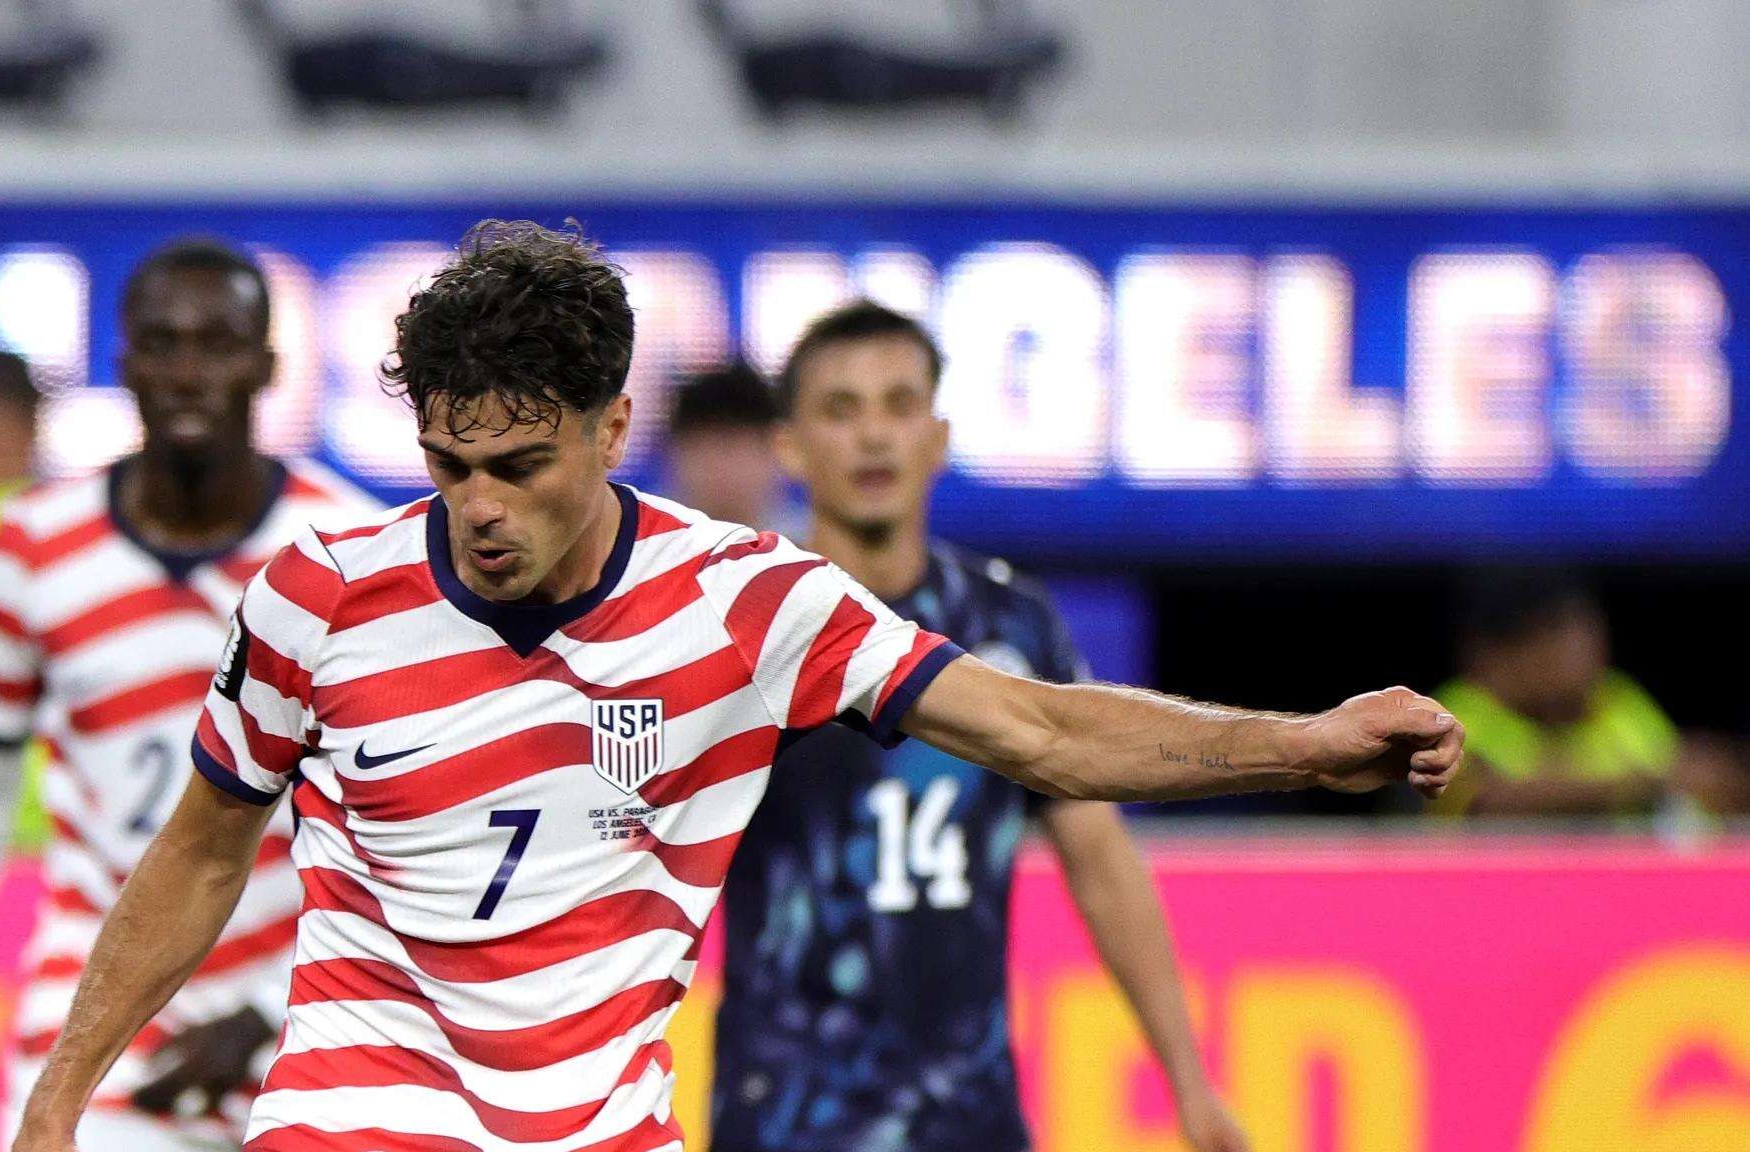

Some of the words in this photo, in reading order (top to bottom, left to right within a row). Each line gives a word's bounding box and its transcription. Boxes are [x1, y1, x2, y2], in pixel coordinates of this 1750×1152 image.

[597, 704, 657, 739] USA
[588, 809, 604, 818] USA
[593, 819, 608, 829] LOS
[611, 830, 631, 840] JUNE
[866, 776, 972, 912] 14
[472, 808, 541, 920] 7
